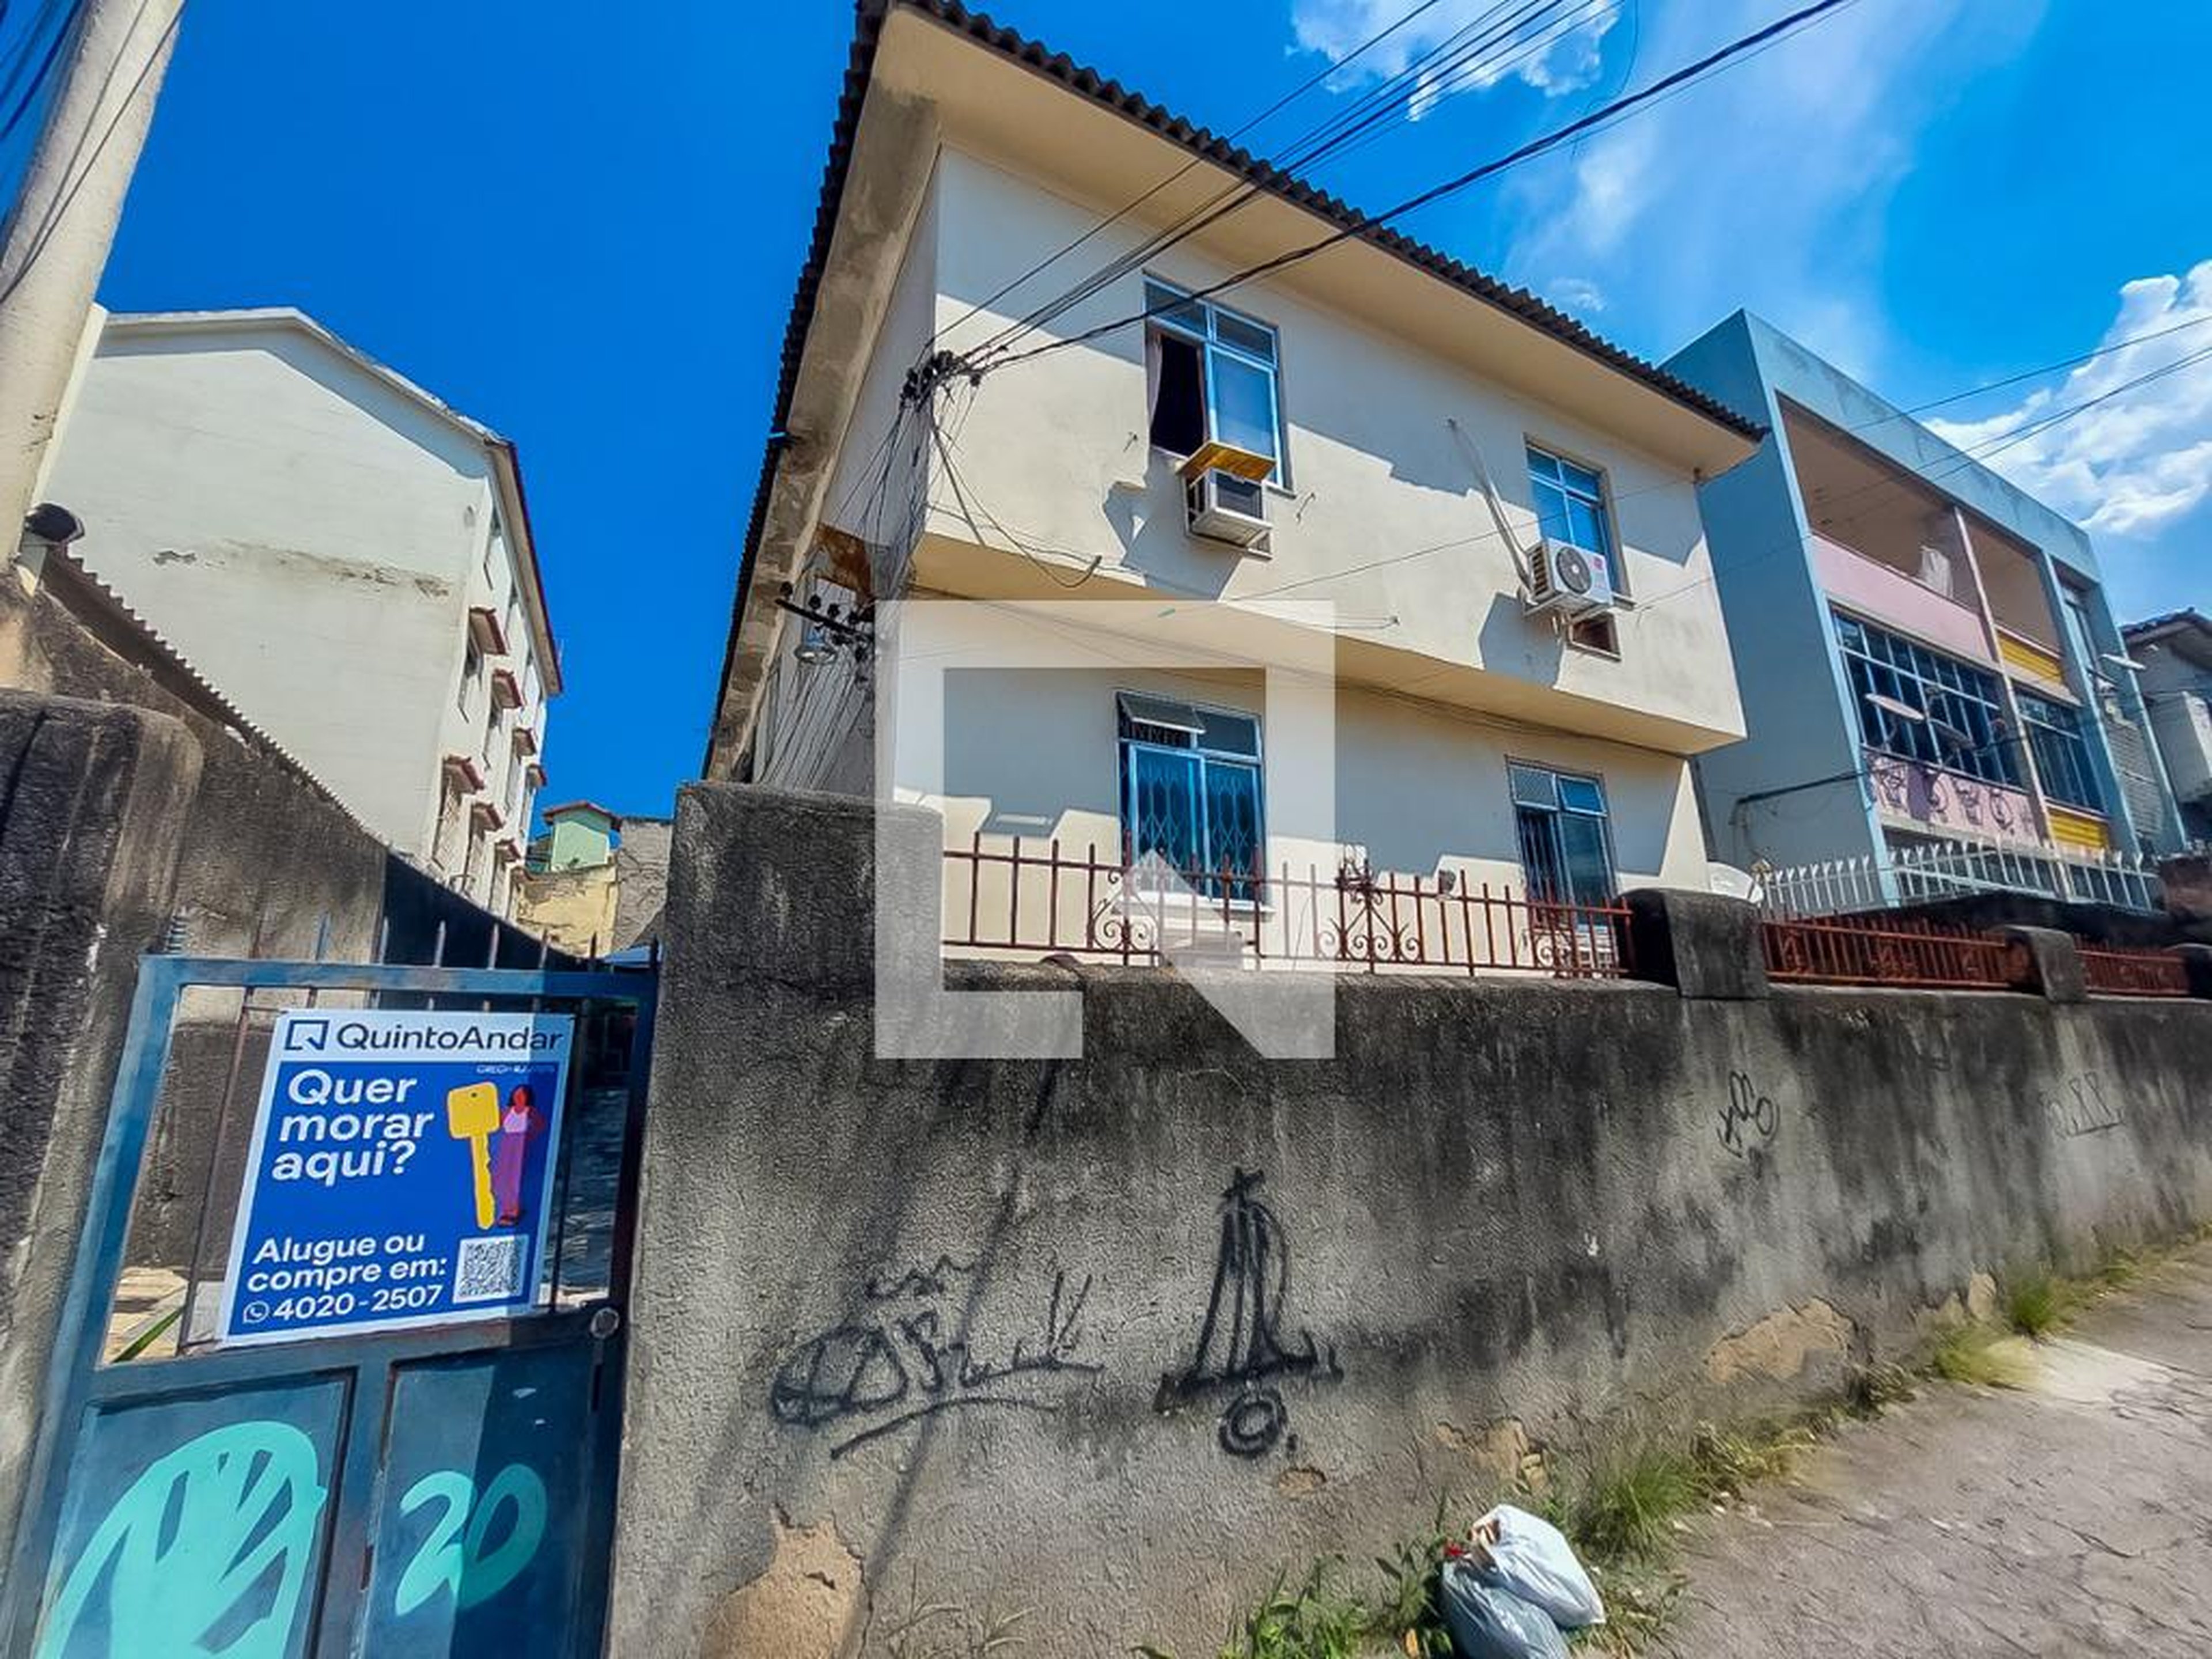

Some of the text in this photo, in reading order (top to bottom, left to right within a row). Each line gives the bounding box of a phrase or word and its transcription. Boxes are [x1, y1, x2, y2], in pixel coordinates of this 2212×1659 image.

[336, 1023, 563, 1051] QuintoAndar
[288, 1069, 417, 1105] Quer
[279, 1112, 434, 1142] morar
[272, 1141, 416, 1186] aqui?
[252, 1234, 425, 1266] Alugue ou
[248, 1257, 446, 1292] compre em:
